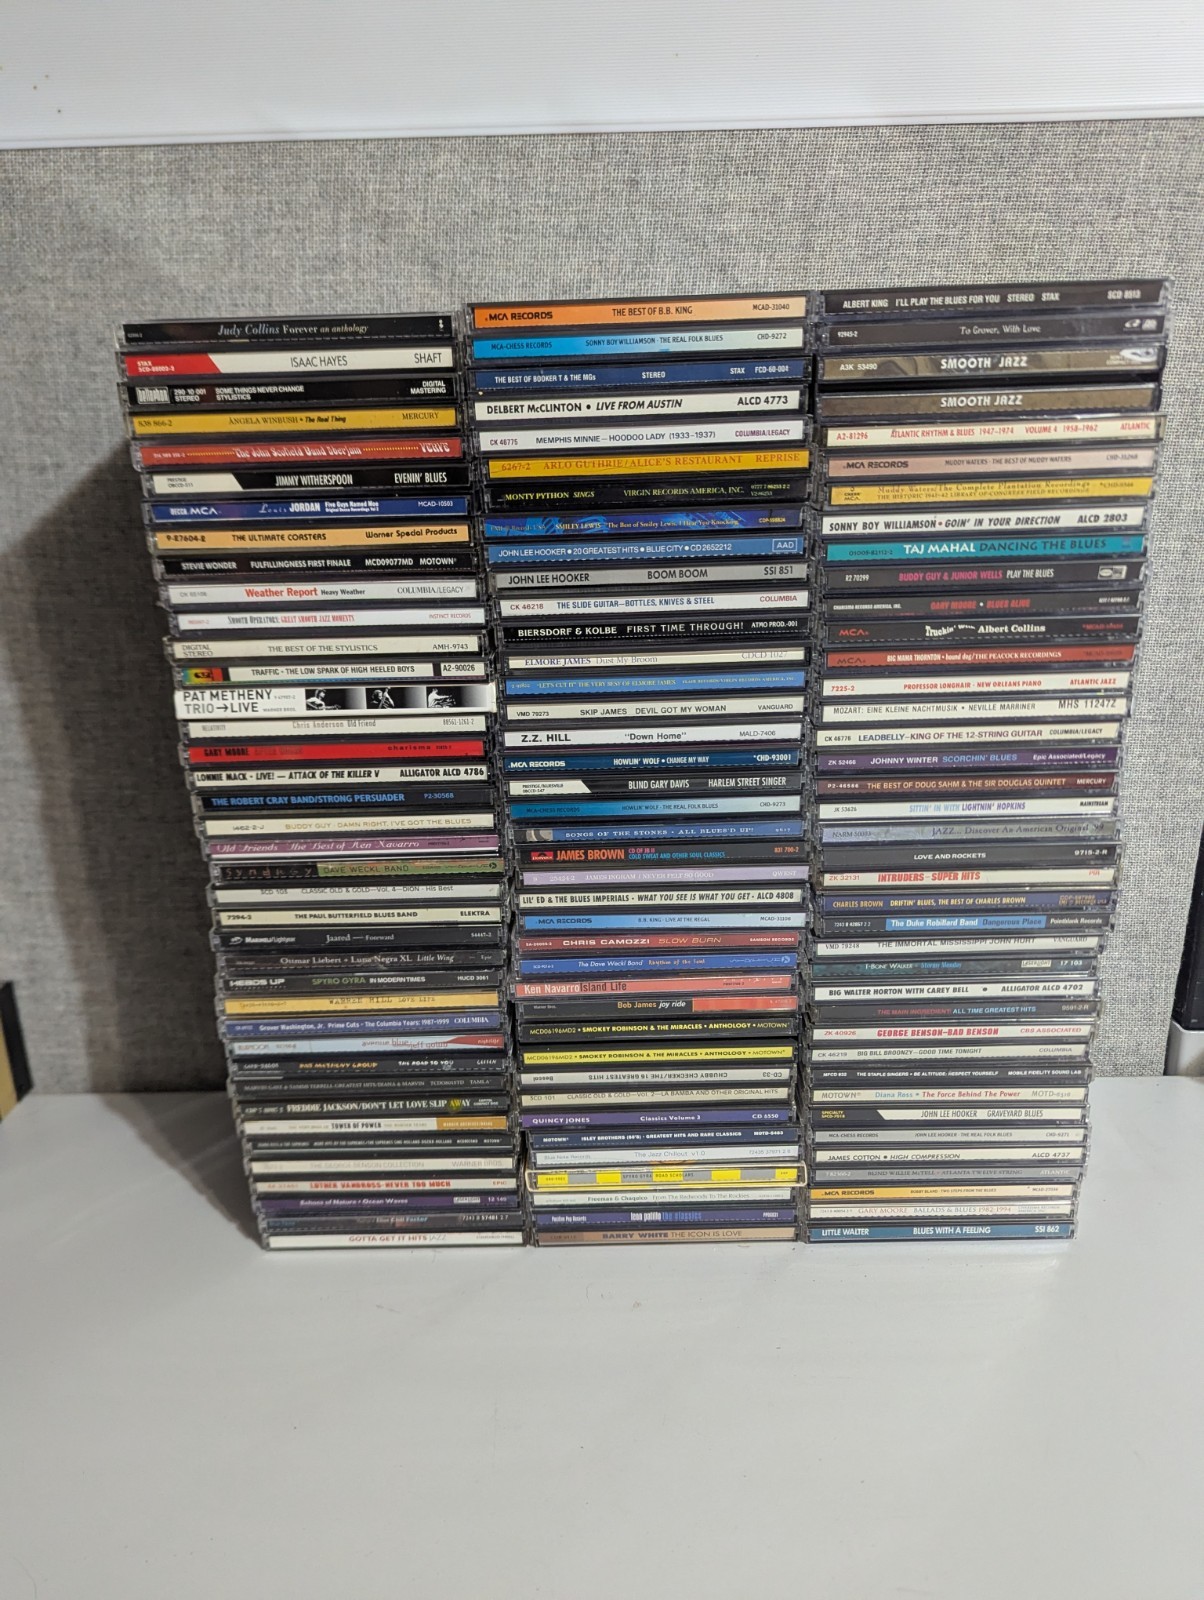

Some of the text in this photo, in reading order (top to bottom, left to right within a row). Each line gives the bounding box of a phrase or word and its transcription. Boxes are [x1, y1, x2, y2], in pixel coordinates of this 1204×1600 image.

[752, 303, 790, 311] MCAD-31040
[842, 299, 889, 309] ALBERT KING
[511, 311, 553, 320] RECORDS
[612, 306, 693, 317] THE BEST OF B.B. KING
[217, 324, 242, 337] Judy
[245, 323, 280, 335] Collins
[282, 324, 318, 334] Forever
[331, 323, 368, 334] anthology
[291, 356, 348, 368] ISAAC HAYES
[414, 352, 442, 364] SHAFT
[940, 356, 1027, 369] SMOOTH JAZZ
[641, 371, 666, 379] STEREO
[410, 386, 447, 395] MASTERING
[737, 395, 788, 406] ALCD 4773
[940, 394, 1023, 408] SMOOTH JAZZ
[487, 398, 682, 415] DELBERT McCLINTON LIVE FROM AUSTIN
[402, 411, 439, 421] MERCURY
[275, 473, 353, 487] JIMMY WITHERSPOON
[394, 472, 447, 484] EVENIN' BLUES
[505, 492, 534, 501] MONTY
[536, 491, 569, 500] PYTHON
[829, 515, 1061, 532] SONNY BOY WILLIAMSON GOIN' IN YOUR DIRECTION
[1077, 513, 1128, 524] ALCD 2803
[365, 527, 458, 539] Warner Special Products
[776, 540, 794, 549] AAD
[903, 538, 1107, 555] TAJ MAHAL DANCING THE BLUES
[647, 568, 708, 579] BOOM BOOM
[763, 565, 794, 575] SSI 851
[508, 573, 590, 585] JOHN LEE HOOKER
[245, 587, 318, 597] Weather Report
[977, 623, 1046, 634] Albert Collins
[252, 668, 279, 676] TRAFFIC
[300, 667, 316, 675] LOW
[397, 665, 415, 673] BOYS
[442, 664, 476, 672] A2-90026
[183, 689, 272, 702] PAT METHENY
[230, 702, 259, 713] LIVE
[580, 708, 628, 716] SKIP JAMES
[635, 704, 726, 715] DEVIL GOT MY WOMAN
[521, 733, 571, 743] Z.Z. HILL
[906, 756, 939, 764] WINTER
[942, 754, 988, 763] SCORCHIN'
[990, 753, 1017, 761] BLUES
[400, 767, 484, 777] ALLIGATOR ALCD 4786
[708, 776, 786, 787] HARLEM STREET SINGER
[556, 849, 625, 861] JAMES BROWN
[878, 872, 980, 882] INTRUDERS SUPER HITS
[600, 938, 650, 946] CAMOZZI
[524, 984, 542, 994] Ken
[610, 981, 627, 991] Life
[844, 988, 872, 996] WALTER
[905, 987, 925, 995] WITH
[617, 1000, 686, 1010] Bob James joy ride
[388, 1101, 405, 1109] LET
[406, 1100, 428, 1109] LOVE
[429, 1100, 447, 1108] SLIP
[921, 1109, 978, 1118] JOHN LEE HOOKER
[987, 1109, 1043, 1118] GRAVEYARD BLUES
[532, 1117, 563, 1125] QUINCY
[842, 1228, 869, 1236] WALTER
[913, 1227, 934, 1235] BLUES
[935, 1226, 953, 1235] WITH
[962, 1226, 991, 1234] FEELING
[1034, 1224, 1060, 1233] SSI 862
[637, 1231, 669, 1239] WHITE
[687, 1230, 711, 1238] ICON
